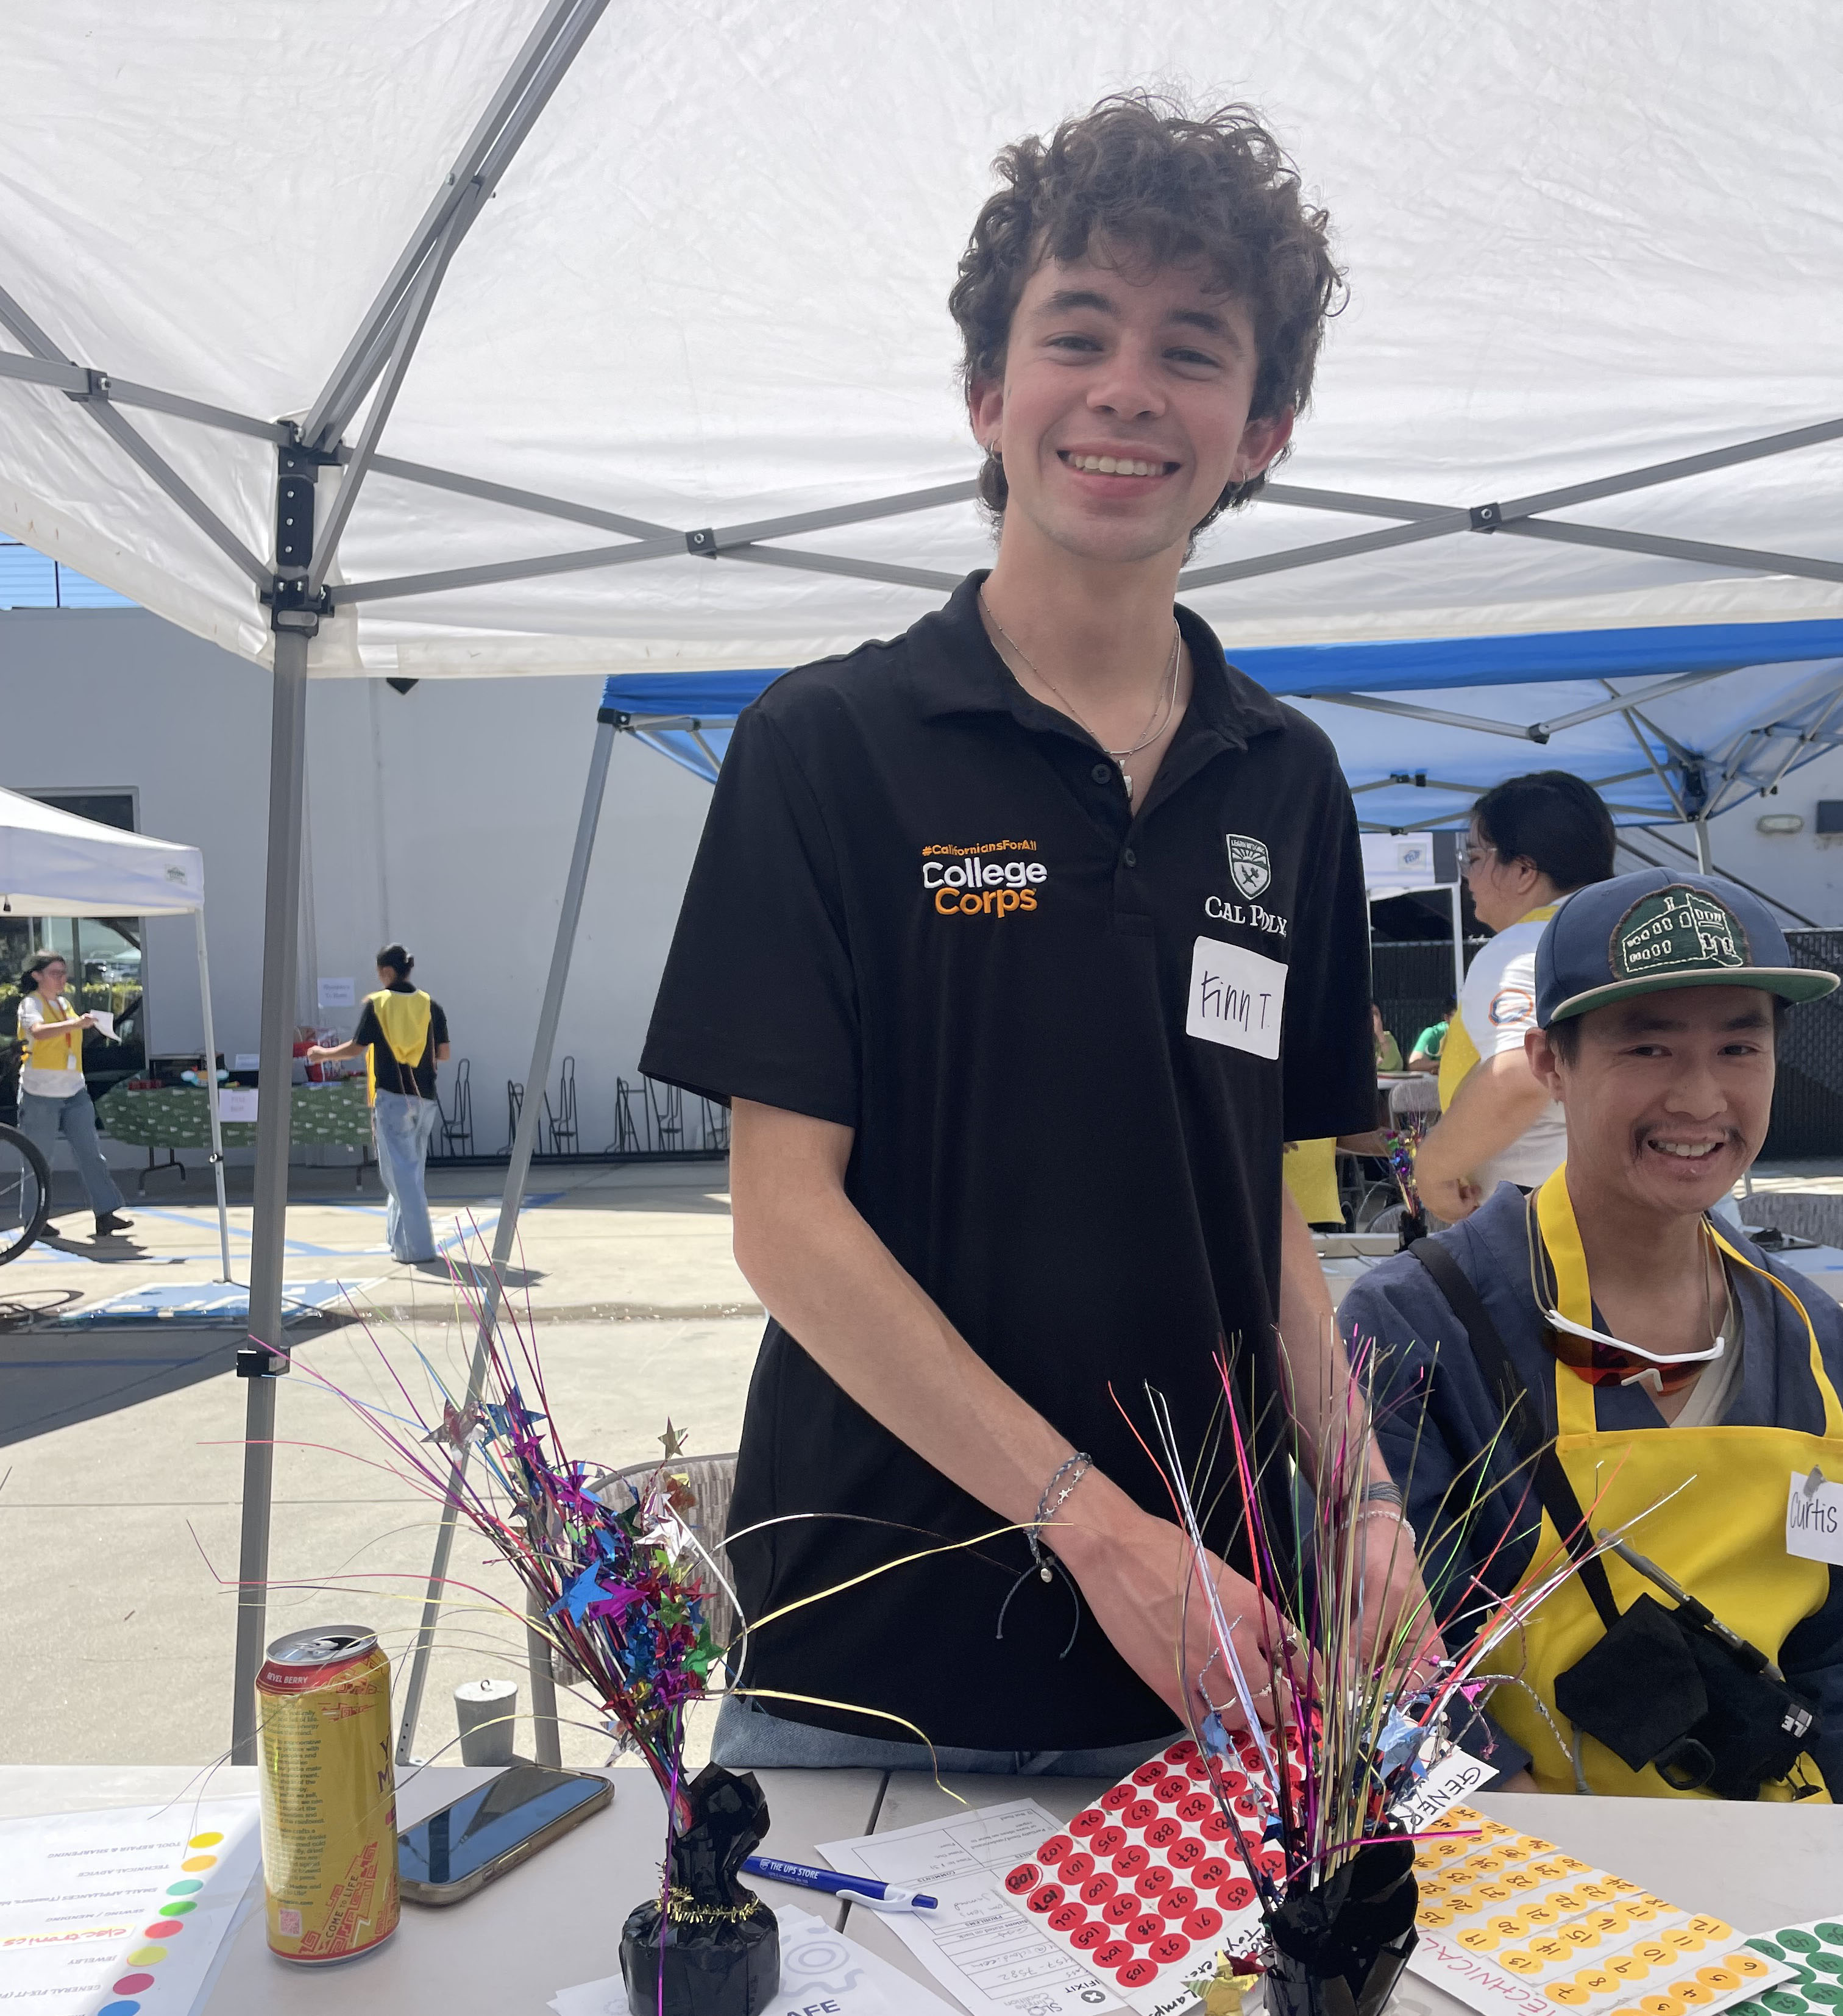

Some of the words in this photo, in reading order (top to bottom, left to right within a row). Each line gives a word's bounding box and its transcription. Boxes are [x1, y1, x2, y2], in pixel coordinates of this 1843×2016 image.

[922, 839, 1037, 857] #CaliforniansForAll
[923, 857, 1048, 889] College
[935, 887, 1038, 919] Corps
[1205, 896, 1246, 925] CAL
[1249, 904, 1287, 935] POLY
[1201, 970, 1251, 1032] Finn
[1790, 1492, 1838, 1533] Curtis
[1139, 1767, 1161, 1782] 84
[1161, 1782, 1182, 1798] 83
[1111, 1790, 1128, 1804] 90
[1132, 1805, 1149, 1820] 89
[1183, 1800, 1206, 1816] 82
[1081, 1812, 1099, 1826] 96
[1210, 1817, 1229, 1832] 81
[1154, 1824, 1174, 1842] 88
[1486, 1822, 1509, 1834] 42
[119, 1843, 154, 1852] REPAIR
[1099, 1833, 1117, 1851] 95
[47, 1848, 109, 1858] SHARPENING
[1042, 1843, 1063, 1861] 102
[1176, 1844, 1198, 1862] 87
[1440, 1845, 1457, 1854] 40
[1118, 1851, 1140, 1868] 94
[1471, 1858, 1498, 1868] 34
[1563, 1859, 1582, 1868] 30
[77, 1868, 114, 1878] ADVICE
[115, 1864, 169, 1873] TECHNICAL
[770, 1861, 783, 1872] THE
[783, 1864, 797, 1875] UPS
[797, 1868, 820, 1879] STORE
[1067, 1861, 1084, 1875] 101
[1203, 1865, 1222, 1880] 86
[1535, 1865, 1559, 1875] 29
[917, 1871, 956, 1883] COMMENTS
[1008, 1868, 1034, 1890] 108
[1145, 1872, 1165, 1890] 93
[1447, 1873, 1471, 1882] 33
[1507, 1876, 1532, 1886] 28
[124, 1886, 158, 1895] SMALL
[1089, 1879, 1107, 1897] 100
[1420, 1882, 1446, 1894] 32
[1582, 1884, 1605, 1896] 23
[1607, 1879, 1634, 1889] 24
[62, 1890, 123, 1901] APPLIANCES
[1228, 1887, 1248, 1906] 85
[1480, 1887, 1505, 1898] 27
[1034, 1890, 1057, 1911] 107
[1168, 1893, 1187, 1907] 92
[1446, 1900, 1472, 1910] 26
[1556, 1895, 1579, 1907] 22
[104, 1908, 145, 1917] SEWING
[325, 1911, 344, 1939] COME
[339, 1900, 347, 1908] TO
[343, 1875, 358, 1898] LIFE
[1113, 1900, 1132, 1915] 99
[1627, 1904, 1649, 1917] 17
[45, 1913, 94, 1922] MENDING
[1056, 1909, 1075, 1926] 106
[1419, 1912, 1445, 1923] 25
[1527, 1909, 1549, 1919] 21
[965, 1915, 1004, 1927] PROBLEMS
[1138, 1920, 1156, 1935] 98
[1197, 1914, 1210, 1928] 91
[1499, 1922, 1519, 1933] 20
[1598, 1919, 1616, 1930] 16
[1694, 1920, 1719, 1934] 12
[2, 1928, 127, 1947] electronics
[1079, 1928, 1099, 1945] 105
[1465, 1934, 1486, 1945] 19
[1566, 1931, 1592, 1942] 15
[1674, 1936, 1692, 1945] 11
[1784, 1935, 1809, 1948] 42
[1100, 1947, 1121, 1961] 104
[1160, 1940, 1179, 1956] 97
[1536, 1942, 1560, 1955] 14
[68, 1954, 117, 1965] JEWELRY
[1644, 1950, 1666, 1962] 10
[1509, 1958, 1531, 1968] 13
[1614, 1962, 1631, 1973] 9
[1816, 1959, 1839, 1970] 41
[1126, 1964, 1145, 1980] 103
[1589, 1978, 1606, 1986] 8
[14, 1989, 48, 1998] FIX-IT
[49, 1984, 101, 1995] GENERAL
[1558, 1989, 1574, 1999] 7
[1003, 1992, 1049, 2006] Coalition
[1775, 1996, 1797, 2009] 52
